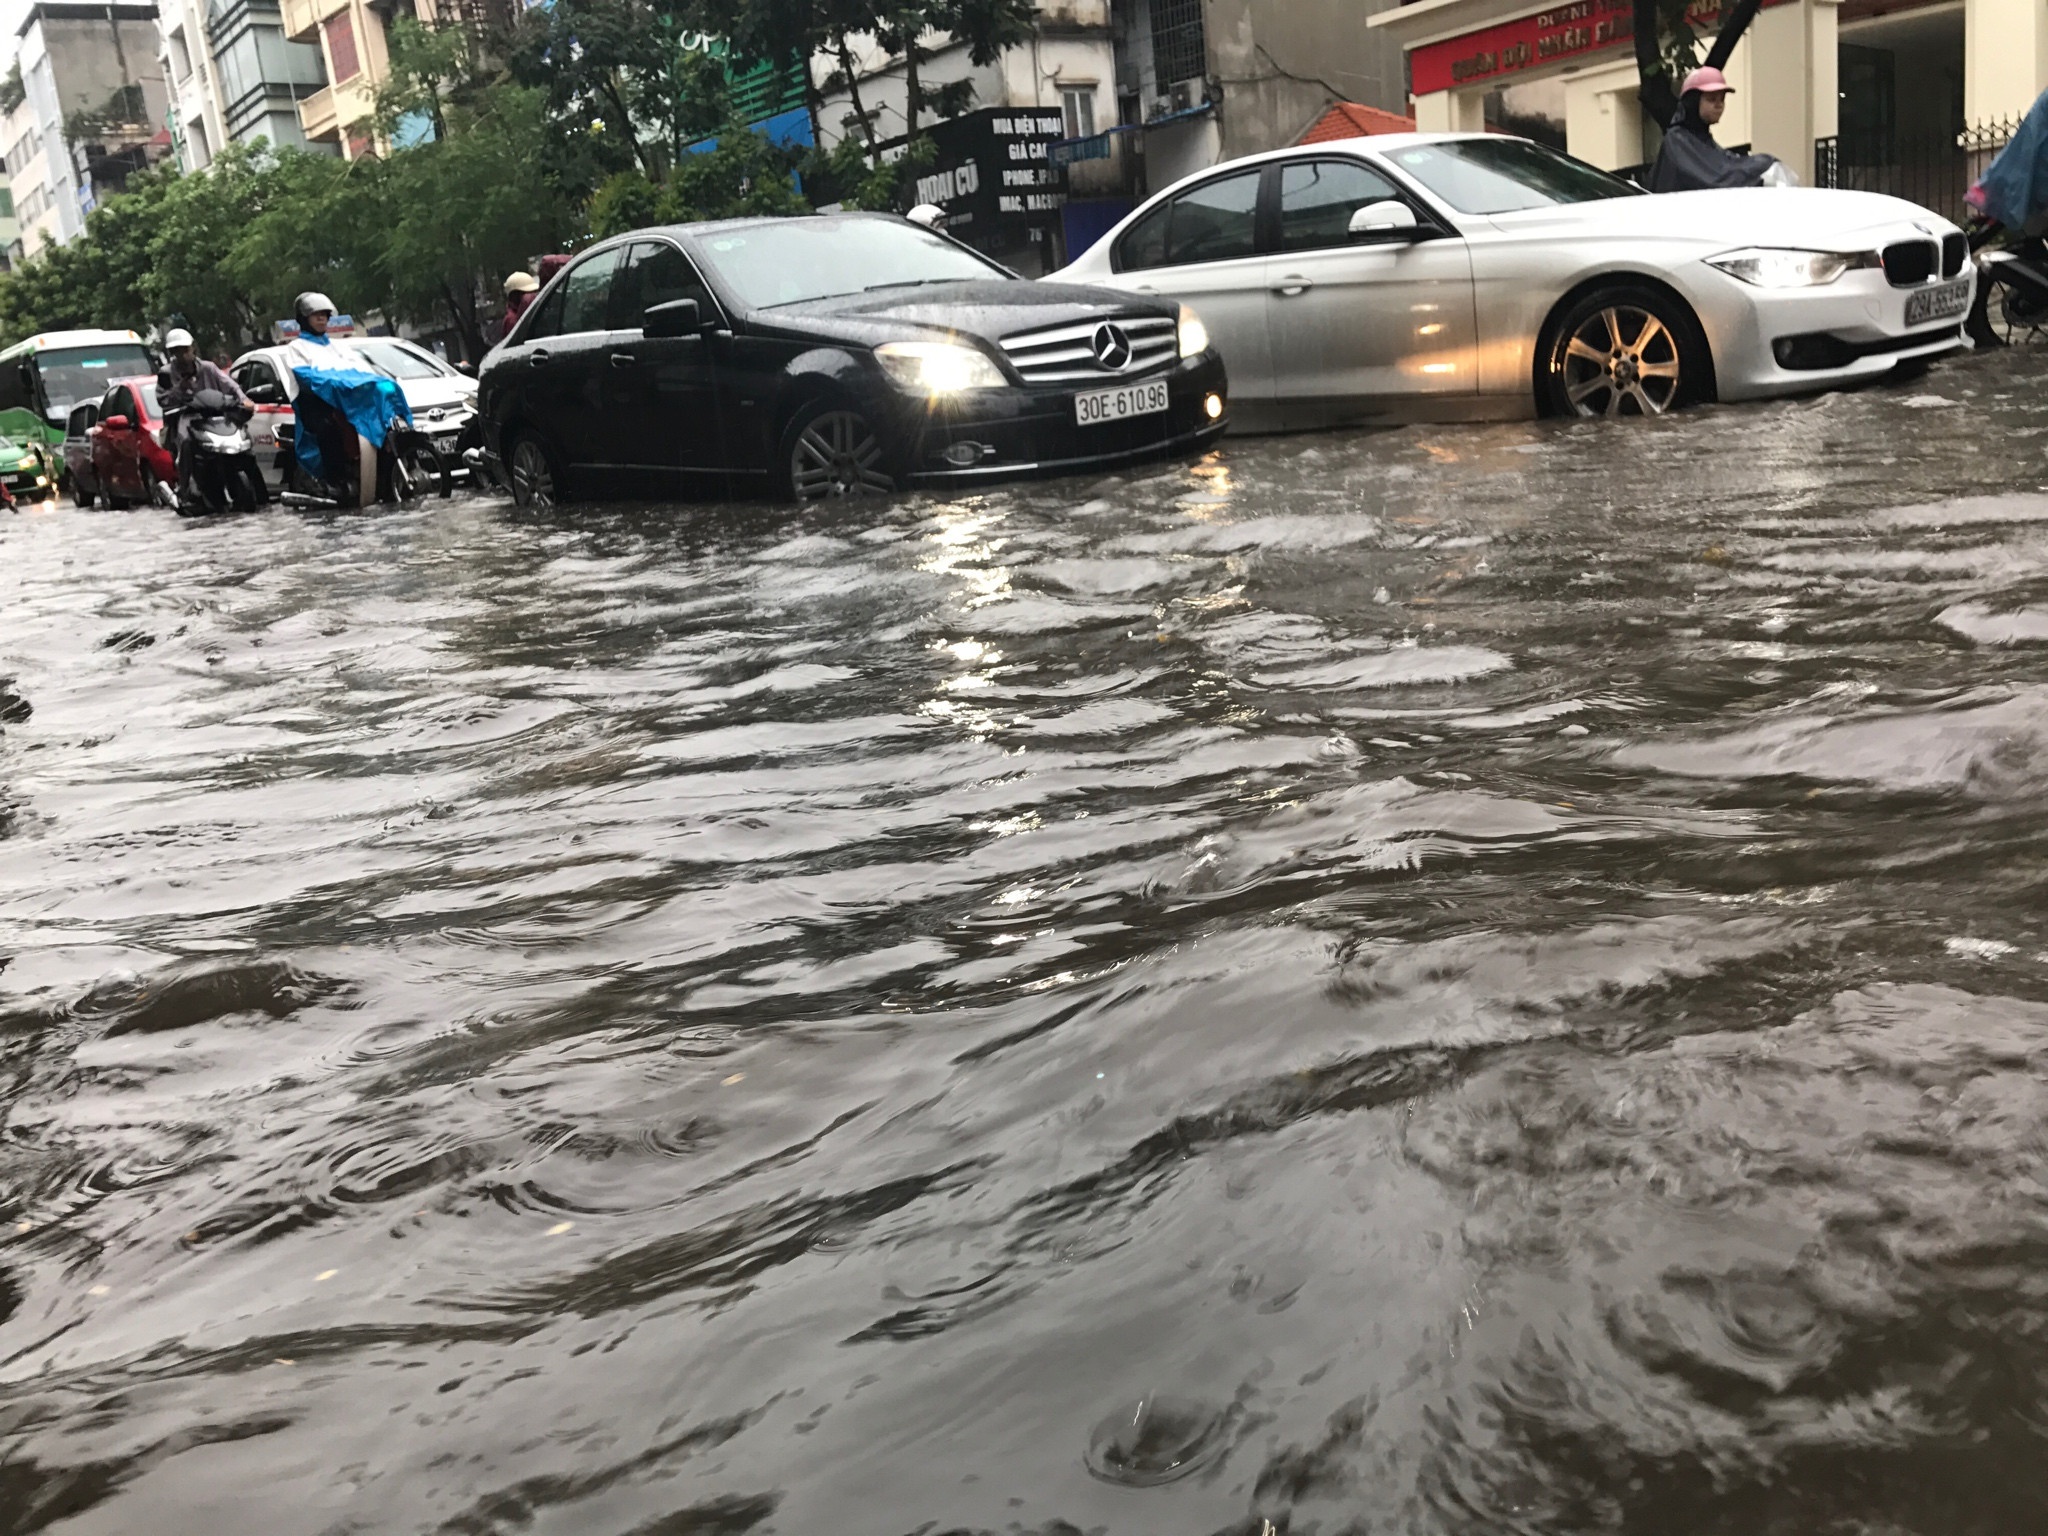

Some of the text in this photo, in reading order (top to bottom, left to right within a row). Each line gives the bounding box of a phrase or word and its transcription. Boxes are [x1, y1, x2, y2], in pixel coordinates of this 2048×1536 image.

[992, 117, 1014, 135] MUA
[1037, 117, 1062, 137] THOẠI
[1008, 140, 1028, 160] GIÁ
